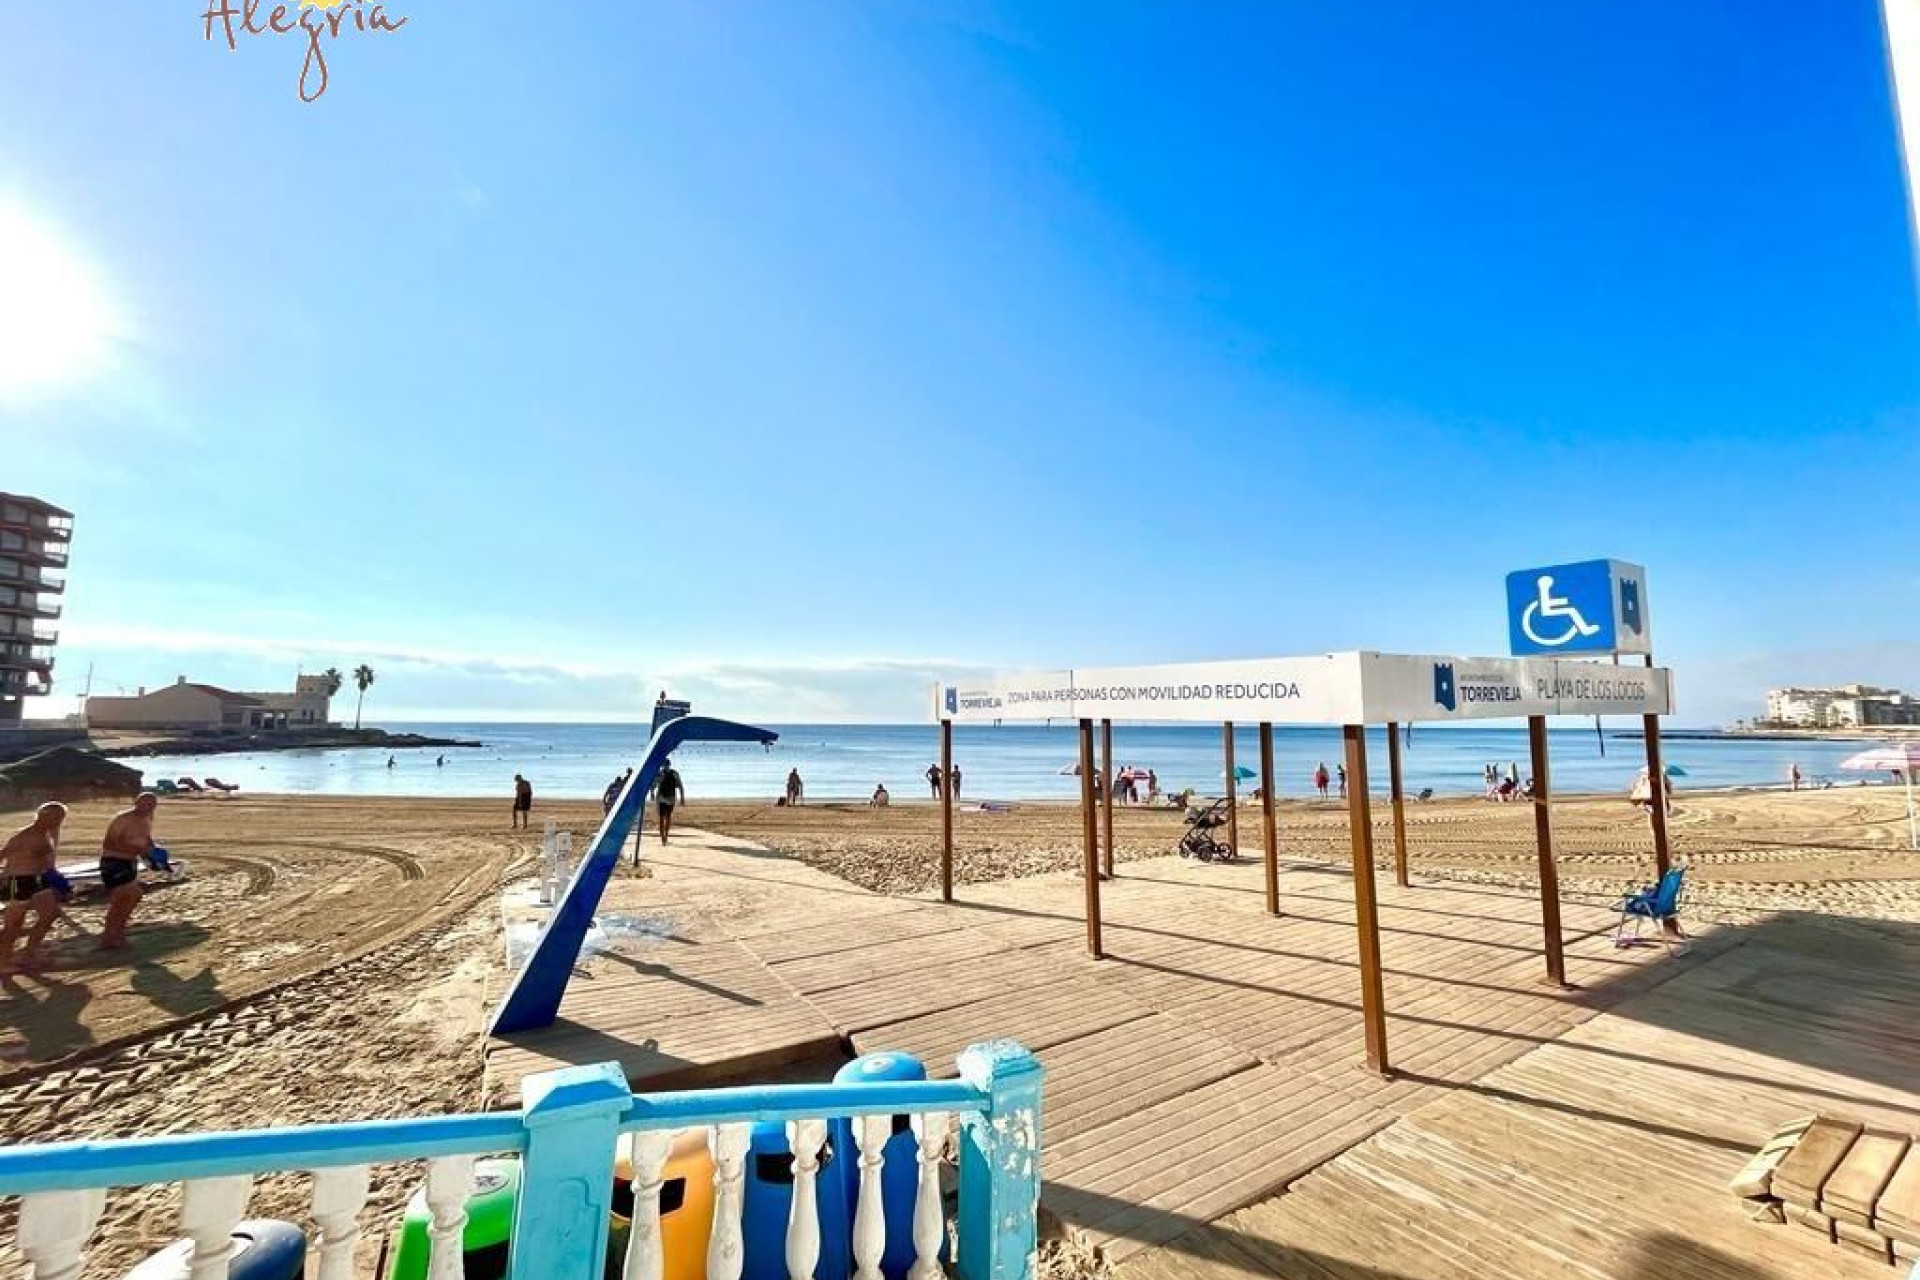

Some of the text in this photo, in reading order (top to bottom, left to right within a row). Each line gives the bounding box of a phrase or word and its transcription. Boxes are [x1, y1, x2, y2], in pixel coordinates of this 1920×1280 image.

[1007, 682, 1300, 704] ZONA PARA PERSONAS CON MOVILIDAD REDUCIDA
[1460, 686, 1522, 702] TORREVIEJA
[1537, 678, 1646, 700] PLAYA DE LOS LOCOS
